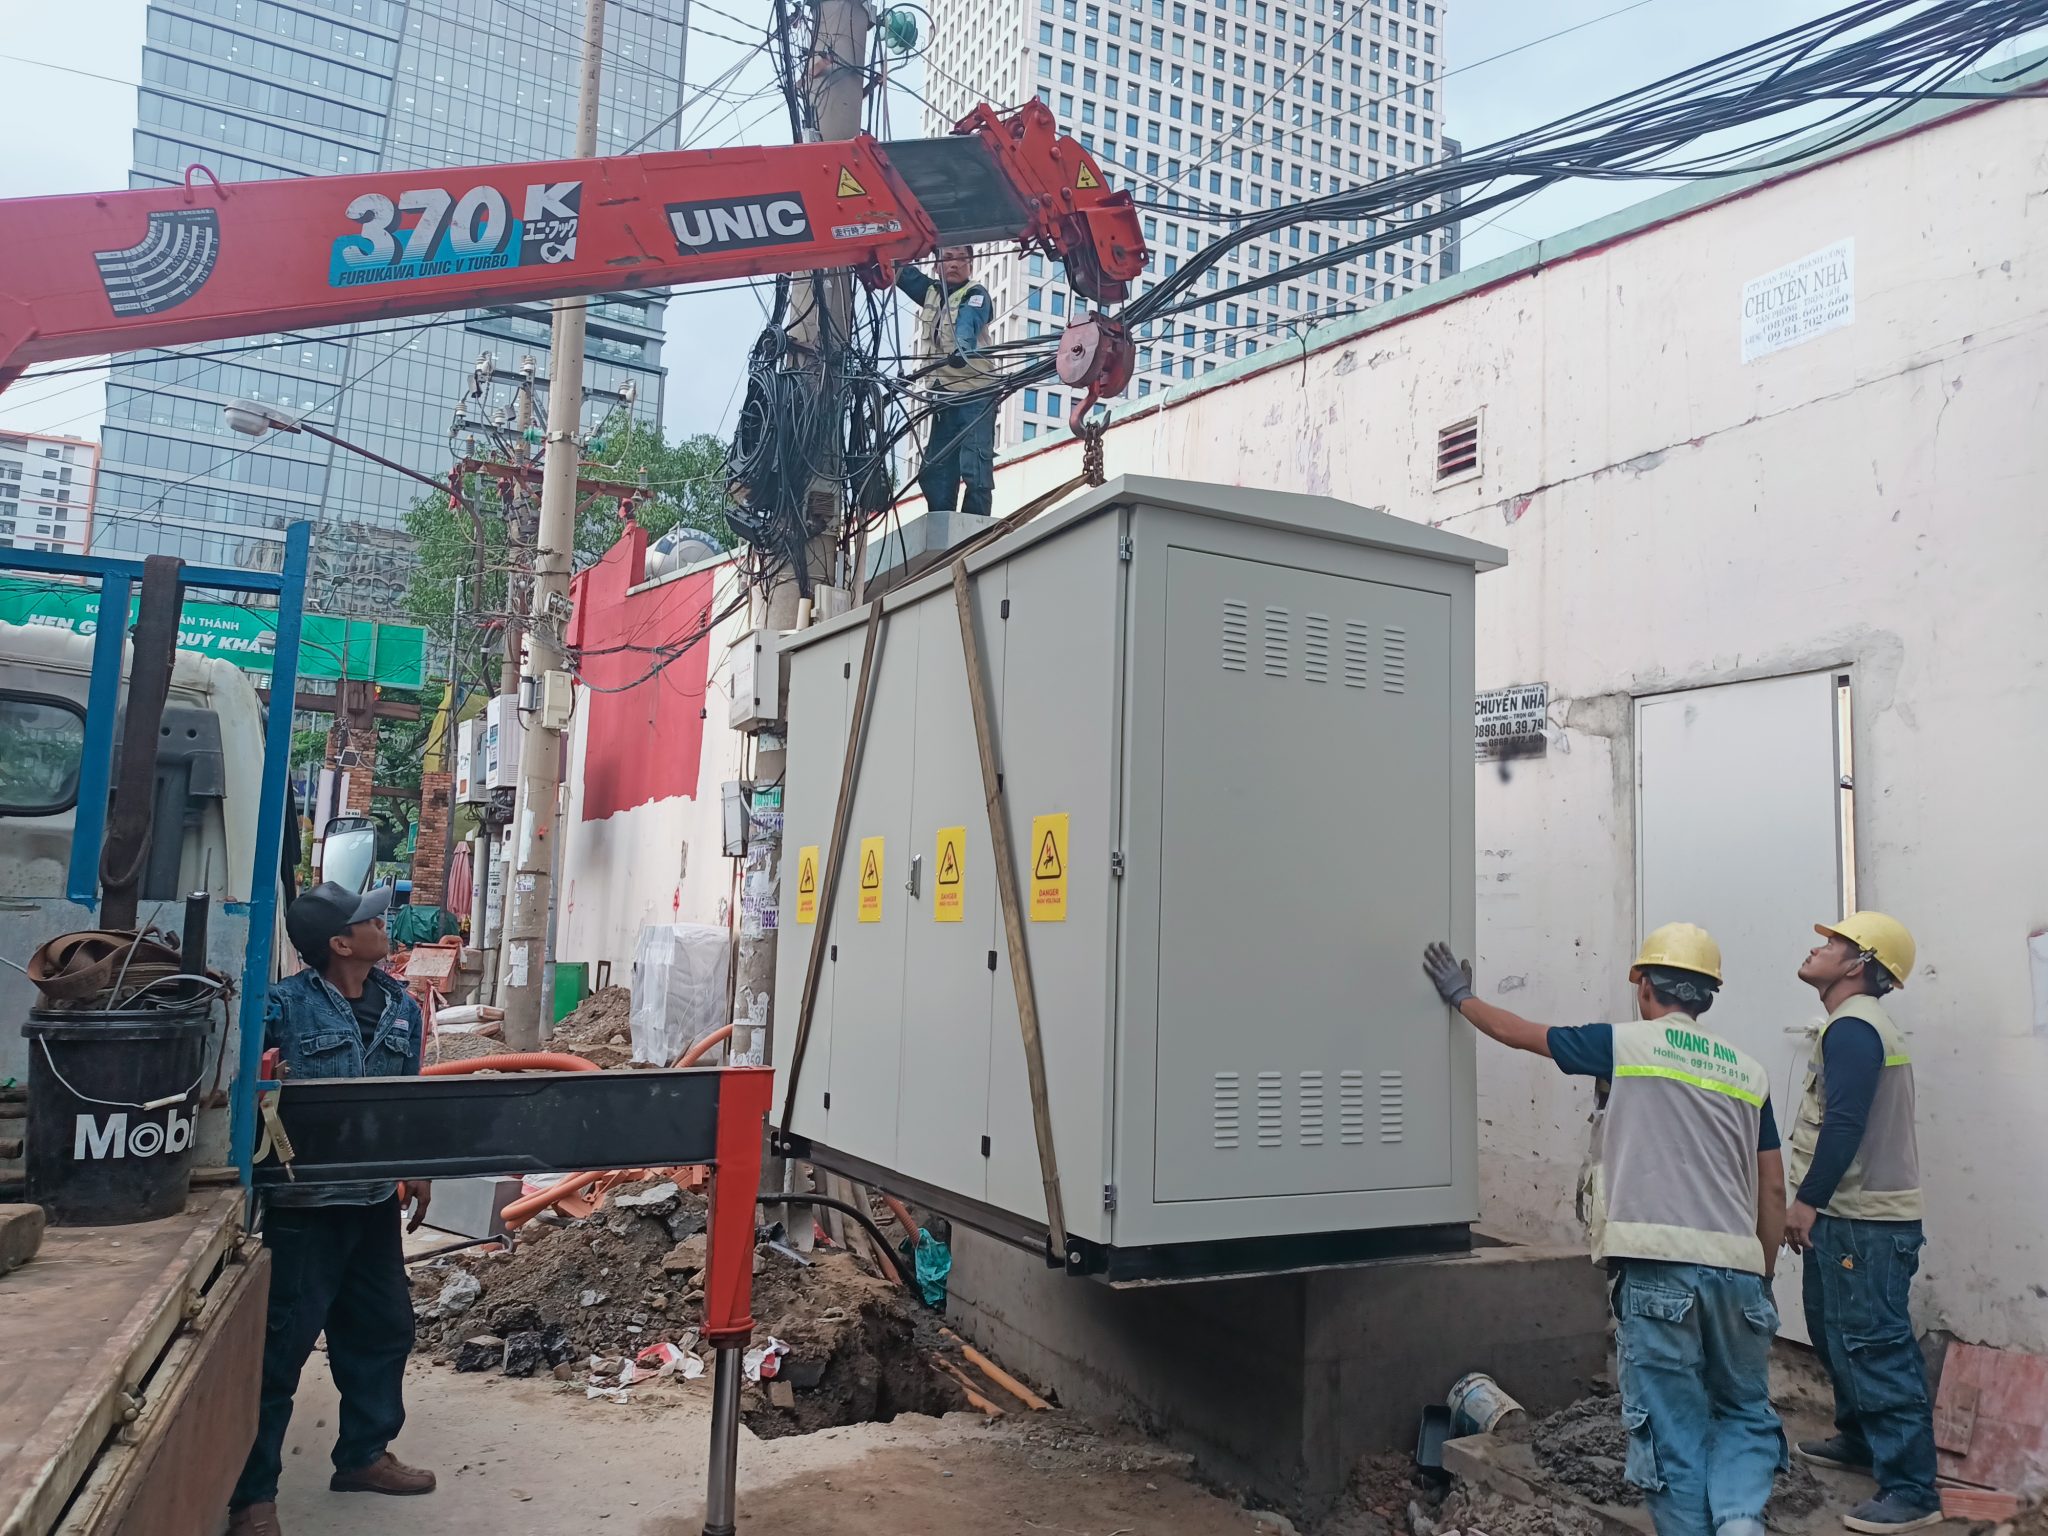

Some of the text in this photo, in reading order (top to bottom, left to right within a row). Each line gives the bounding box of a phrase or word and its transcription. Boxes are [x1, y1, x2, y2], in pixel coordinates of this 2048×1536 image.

[342, 180, 582, 266] 370 K
[669, 199, 806, 247] UNIC
[337, 253, 509, 286] FURUKAWA UNIC V TURBO
[199, 617, 240, 631] THÁNH
[1521, 689, 1545, 710] NHÀ
[1665, 1028, 1738, 1066] QUANG ANH
[1690, 1058, 1714, 1071] 0919
[1715, 1063, 1727, 1075] 75
